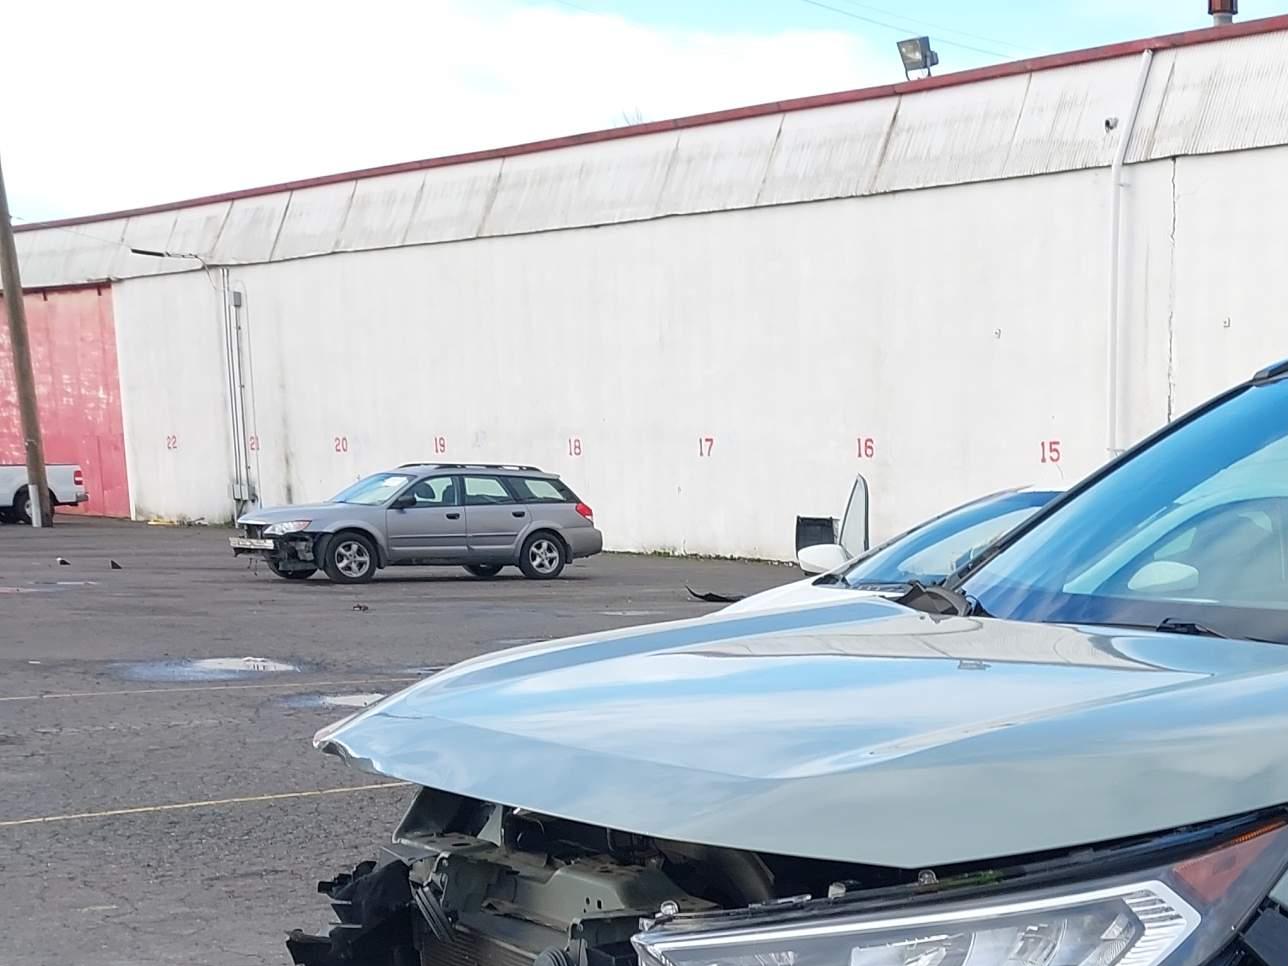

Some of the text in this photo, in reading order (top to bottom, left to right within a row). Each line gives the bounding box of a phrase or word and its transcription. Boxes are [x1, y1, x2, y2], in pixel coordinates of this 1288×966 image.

[166, 435, 177, 450] 22
[334, 436, 348, 453] 20
[433, 436, 446, 454] 19
[568, 438, 582, 456] 18
[699, 438, 714, 457] 17
[856, 438, 874, 458] 16
[1040, 441, 1061, 463] 15
